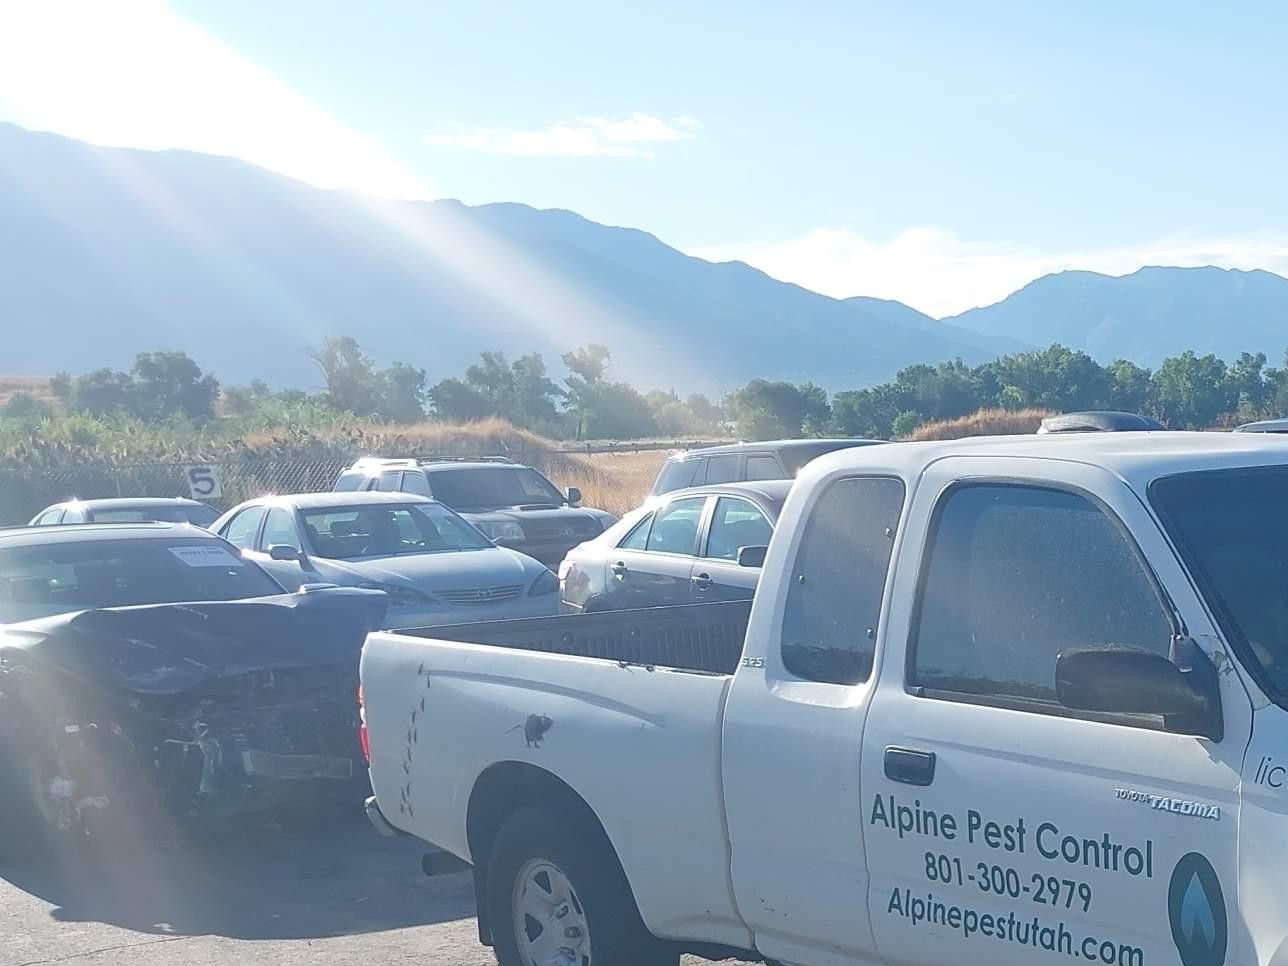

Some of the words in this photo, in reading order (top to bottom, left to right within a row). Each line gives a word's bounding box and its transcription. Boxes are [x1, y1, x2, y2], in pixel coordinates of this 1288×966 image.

[189, 468, 215, 495] 5
[1114, 788, 1150, 803] TOYOTA
[1150, 795, 1221, 820] TACOMA
[870, 793, 957, 840] Alpine
[967, 809, 1026, 853] Pest
[1036, 822, 1153, 878] Control
[924, 851, 1092, 912] 801-300-2979
